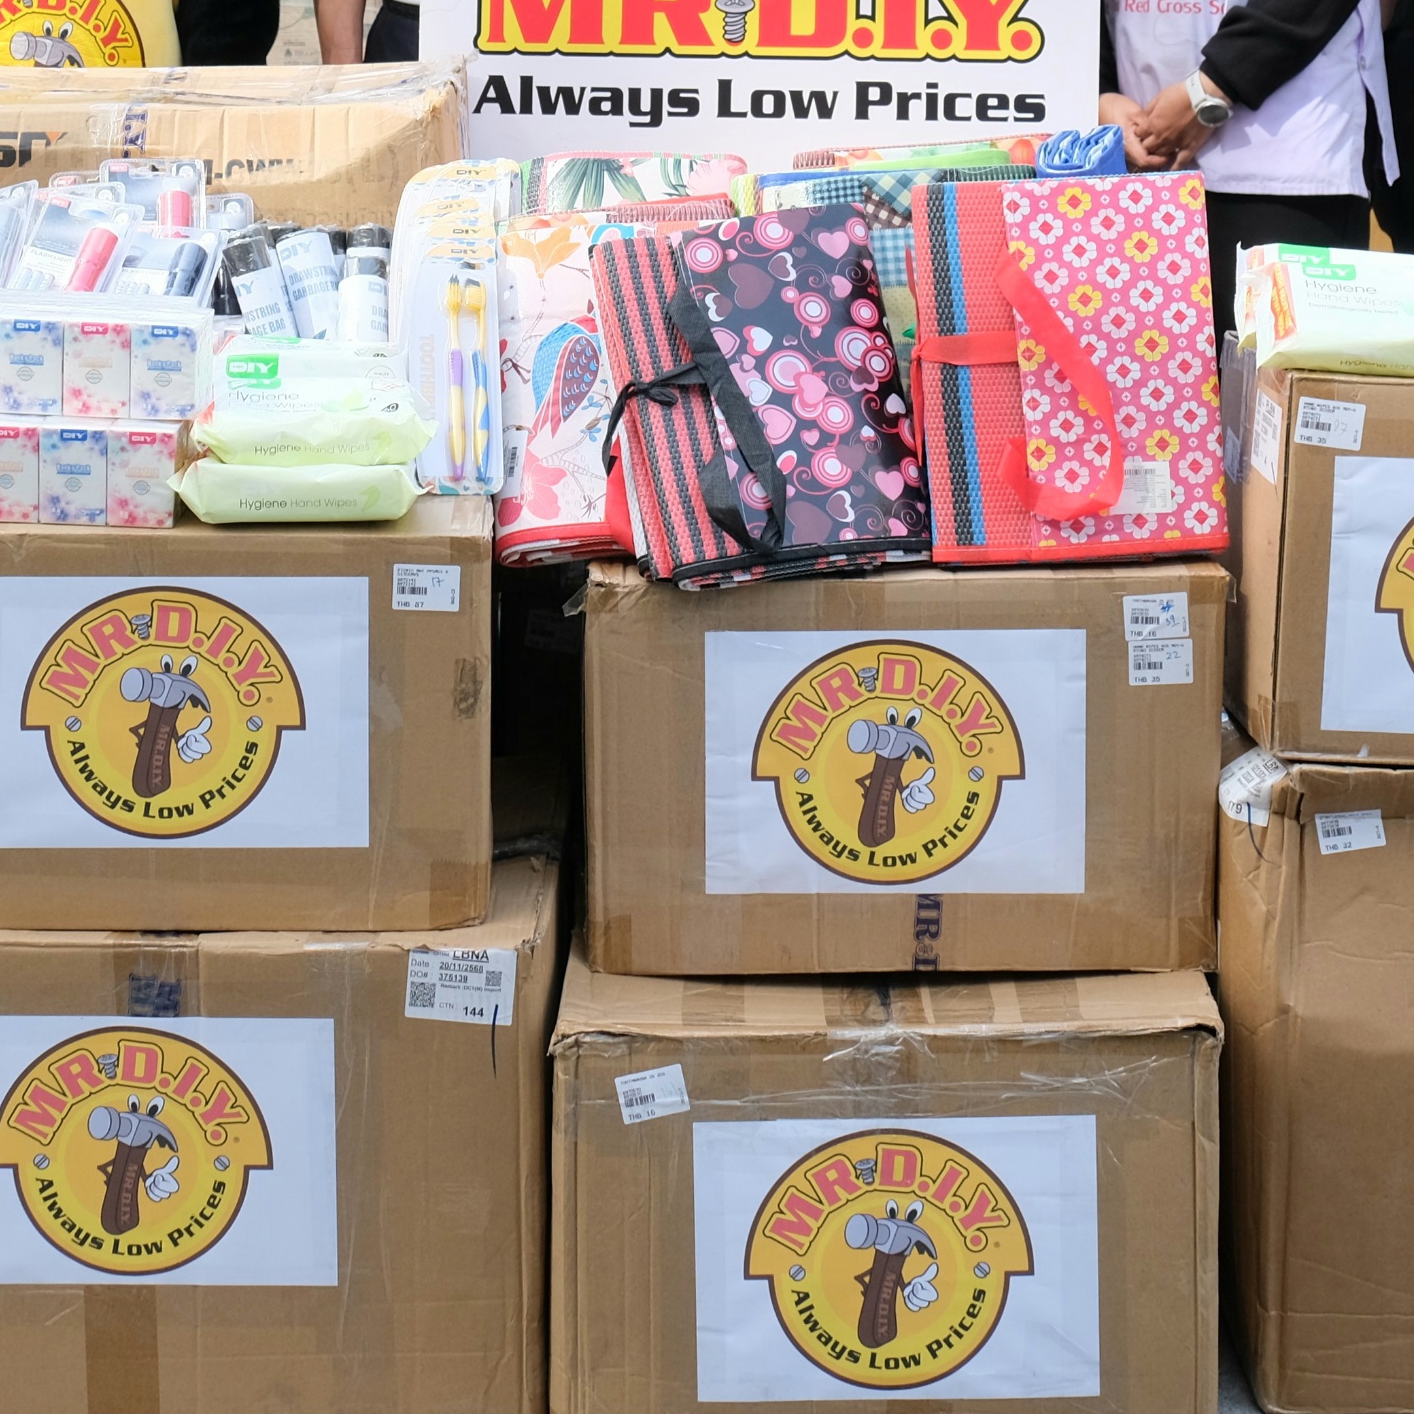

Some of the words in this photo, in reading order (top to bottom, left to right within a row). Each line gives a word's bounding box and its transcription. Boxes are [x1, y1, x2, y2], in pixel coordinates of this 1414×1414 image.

[472, 74, 700, 128] Always
[716, 78, 839, 120] Low
[854, 82, 1047, 123] Prices
[456, 168, 485, 177] DIY
[436, 201, 465, 210] DIY
[452, 227, 481, 236] DIY
[280, 239, 313, 261] DIY
[451, 247, 479, 256] DIY
[292, 281, 330, 302] GARBAGE
[1305, 279, 1377, 295] Hygiene
[1306, 290, 1349, 304] Hand
[1354, 295, 1401, 308] Wipes
[270, 317, 286, 335] BAG
[229, 360, 276, 374] DIY
[1339, 359, 1387, 369] Hygiene
[254, 443, 301, 456] Hygiene
[304, 444, 335, 455] Hand
[336, 442, 370, 455] Wipes
[239, 498, 288, 511] Hygiene
[290, 498, 321, 508] Hand
[324, 497, 358, 510] Wipes
[66, 738, 137, 813] Always
[142, 800, 195, 820] Low
[198, 739, 260, 811] Prices
[794, 788, 863, 866] Always
[867, 849, 920, 869] Low
[922, 787, 981, 861] Prices
[411, 958, 430, 967] Date
[463, 1006, 484, 1018] 144
[35, 1175, 105, 1250] Always
[111, 1236, 164, 1256] Low
[166, 1179, 227, 1248] Prices
[789, 1287, 863, 1366] Always
[867, 1347, 925, 1372] Low
[926, 1286, 987, 1363] Prices
